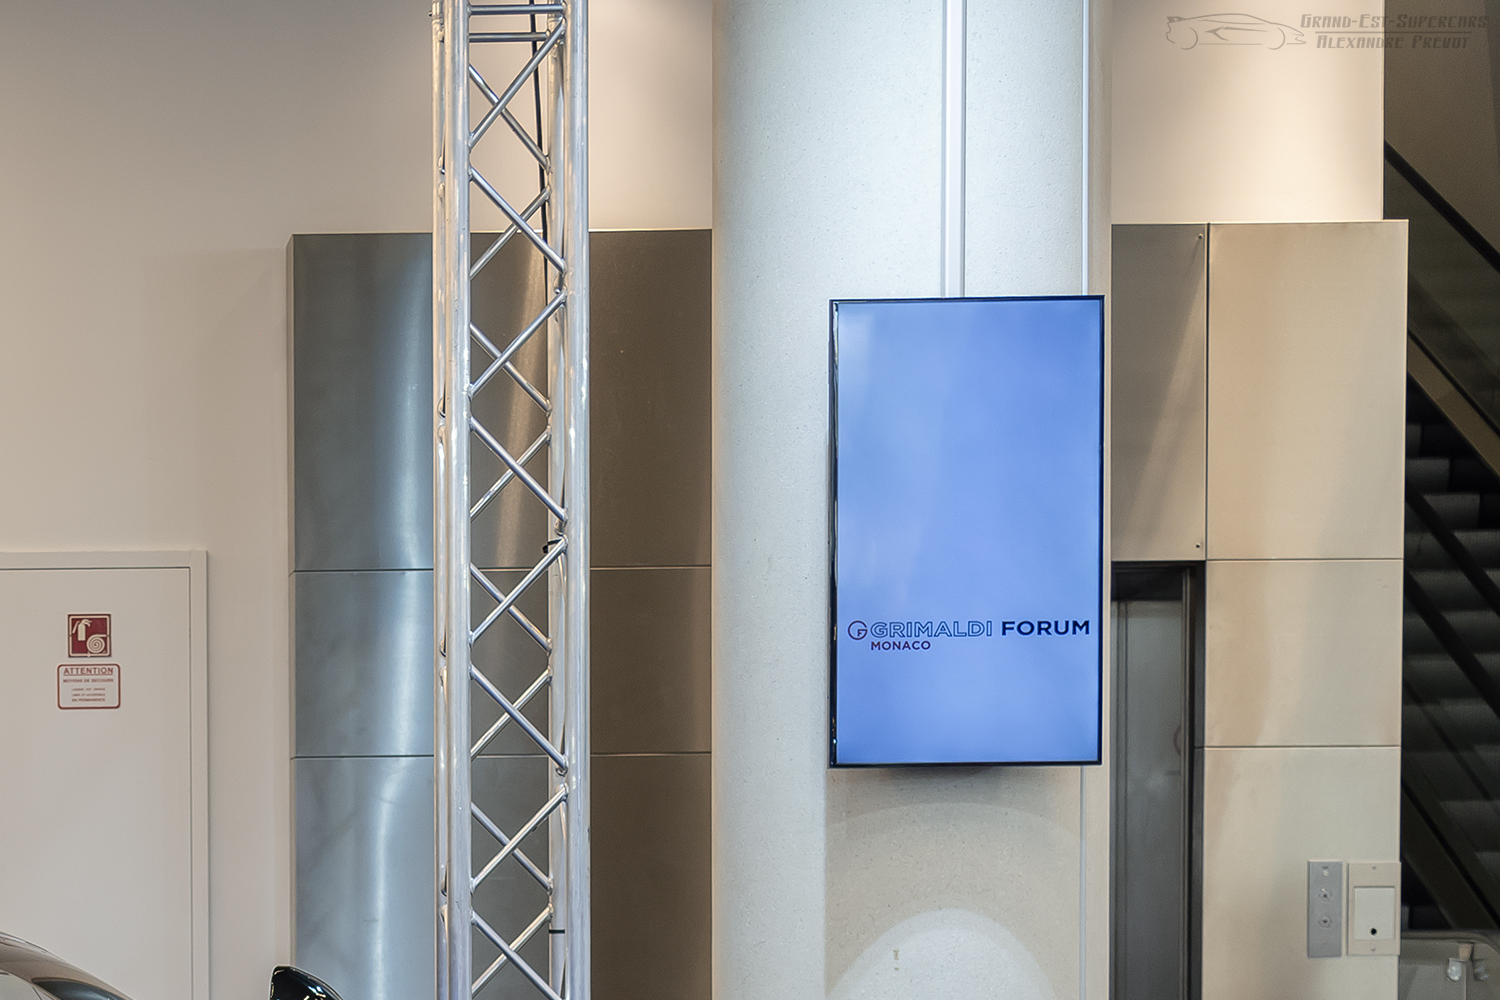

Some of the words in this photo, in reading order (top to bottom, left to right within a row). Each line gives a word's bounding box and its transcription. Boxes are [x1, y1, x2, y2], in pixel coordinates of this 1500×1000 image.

[870, 620, 993, 638] GRIMALDI
[1001, 620, 1090, 636] FORUM
[871, 640, 931, 650] MONACO
[63, 667, 114, 675] ATTENTION
